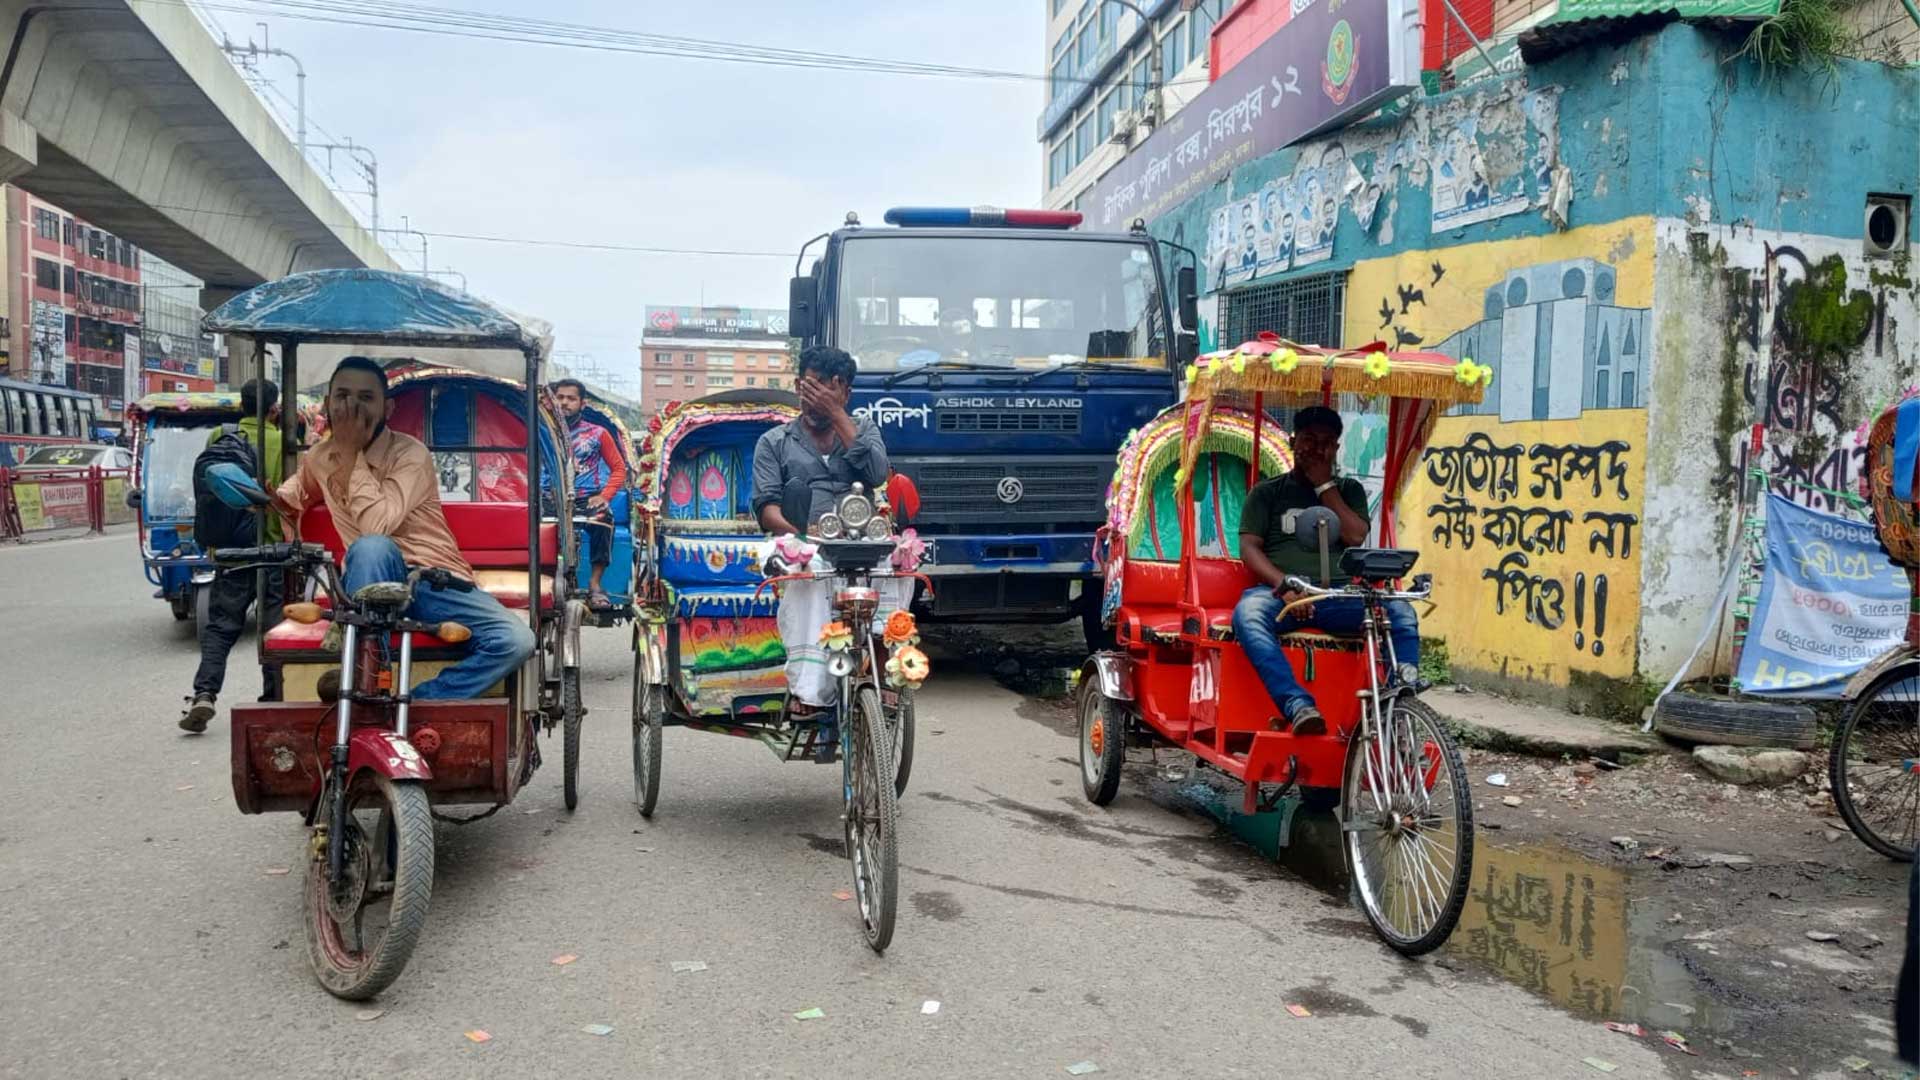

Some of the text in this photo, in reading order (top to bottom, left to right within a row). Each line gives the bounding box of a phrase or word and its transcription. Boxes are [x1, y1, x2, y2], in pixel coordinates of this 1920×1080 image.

[1103, 182, 1137, 225] ট্রাফিক
[1138, 152, 1172, 202] পুলিশ
[1206, 84, 1266, 149] মিরপুর
[1271, 64, 1302, 109] ১২
[935, 398, 1083, 408] ASHOK LEYLAND
[1422, 432, 1631, 503] জাতীয় সম্পদ
[1427, 492, 1639, 559] নষ্ট করো না
